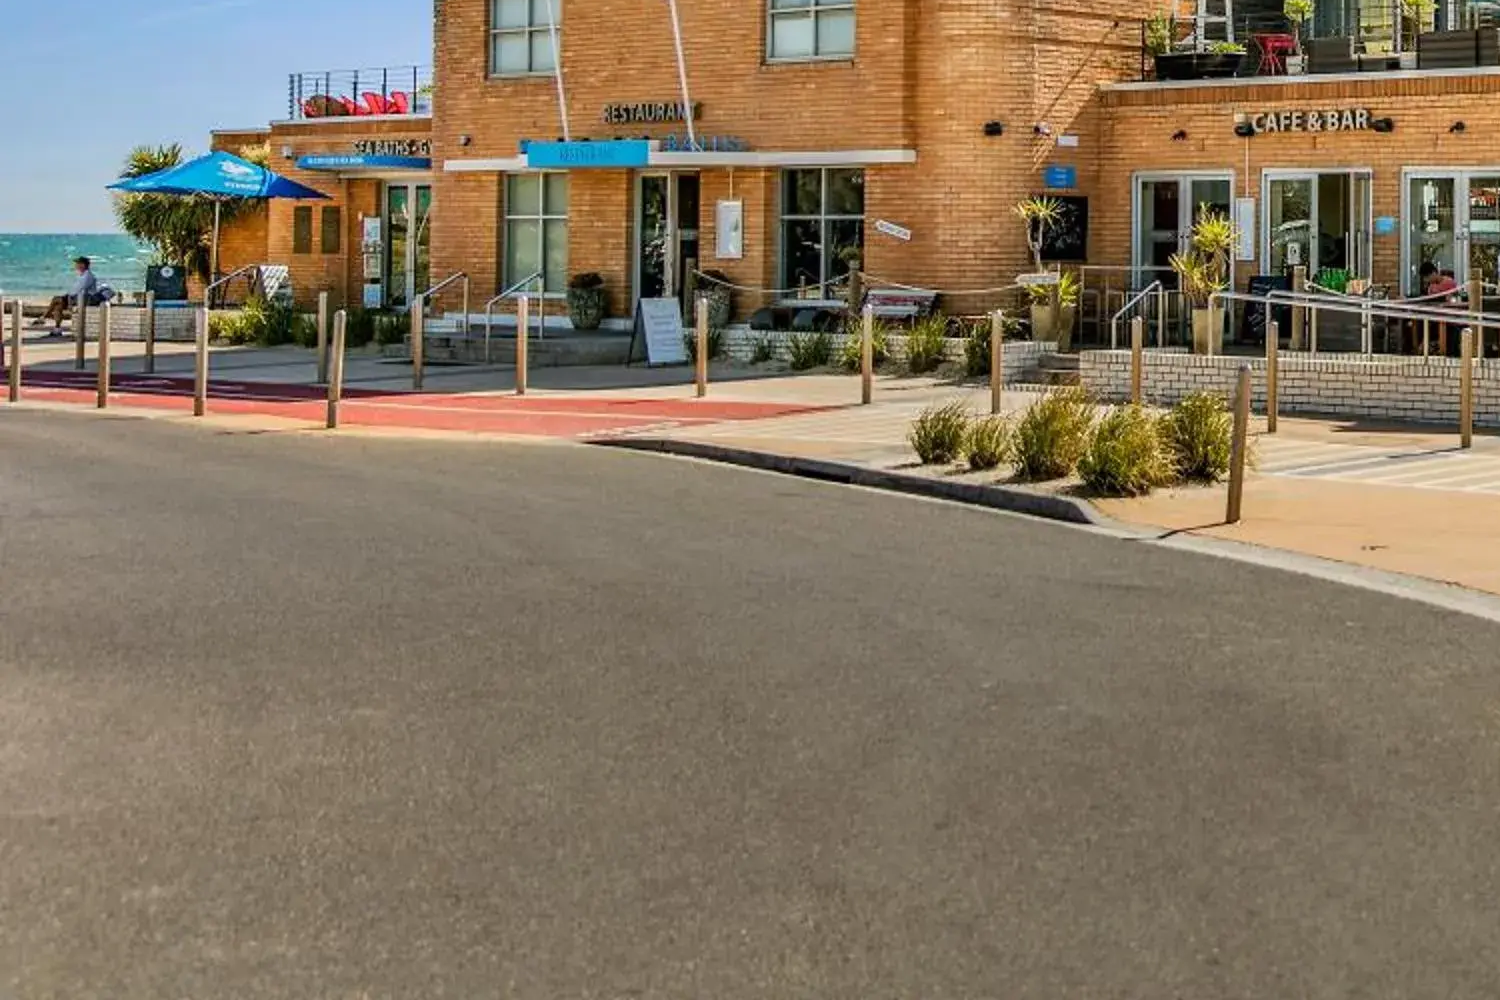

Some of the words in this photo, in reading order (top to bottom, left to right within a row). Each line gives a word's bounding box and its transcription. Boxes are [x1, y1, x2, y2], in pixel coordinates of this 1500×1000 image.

[1251, 111, 1302, 132] CAFE
[1307, 110, 1321, 131] &
[1327, 108, 1369, 130] BAR
